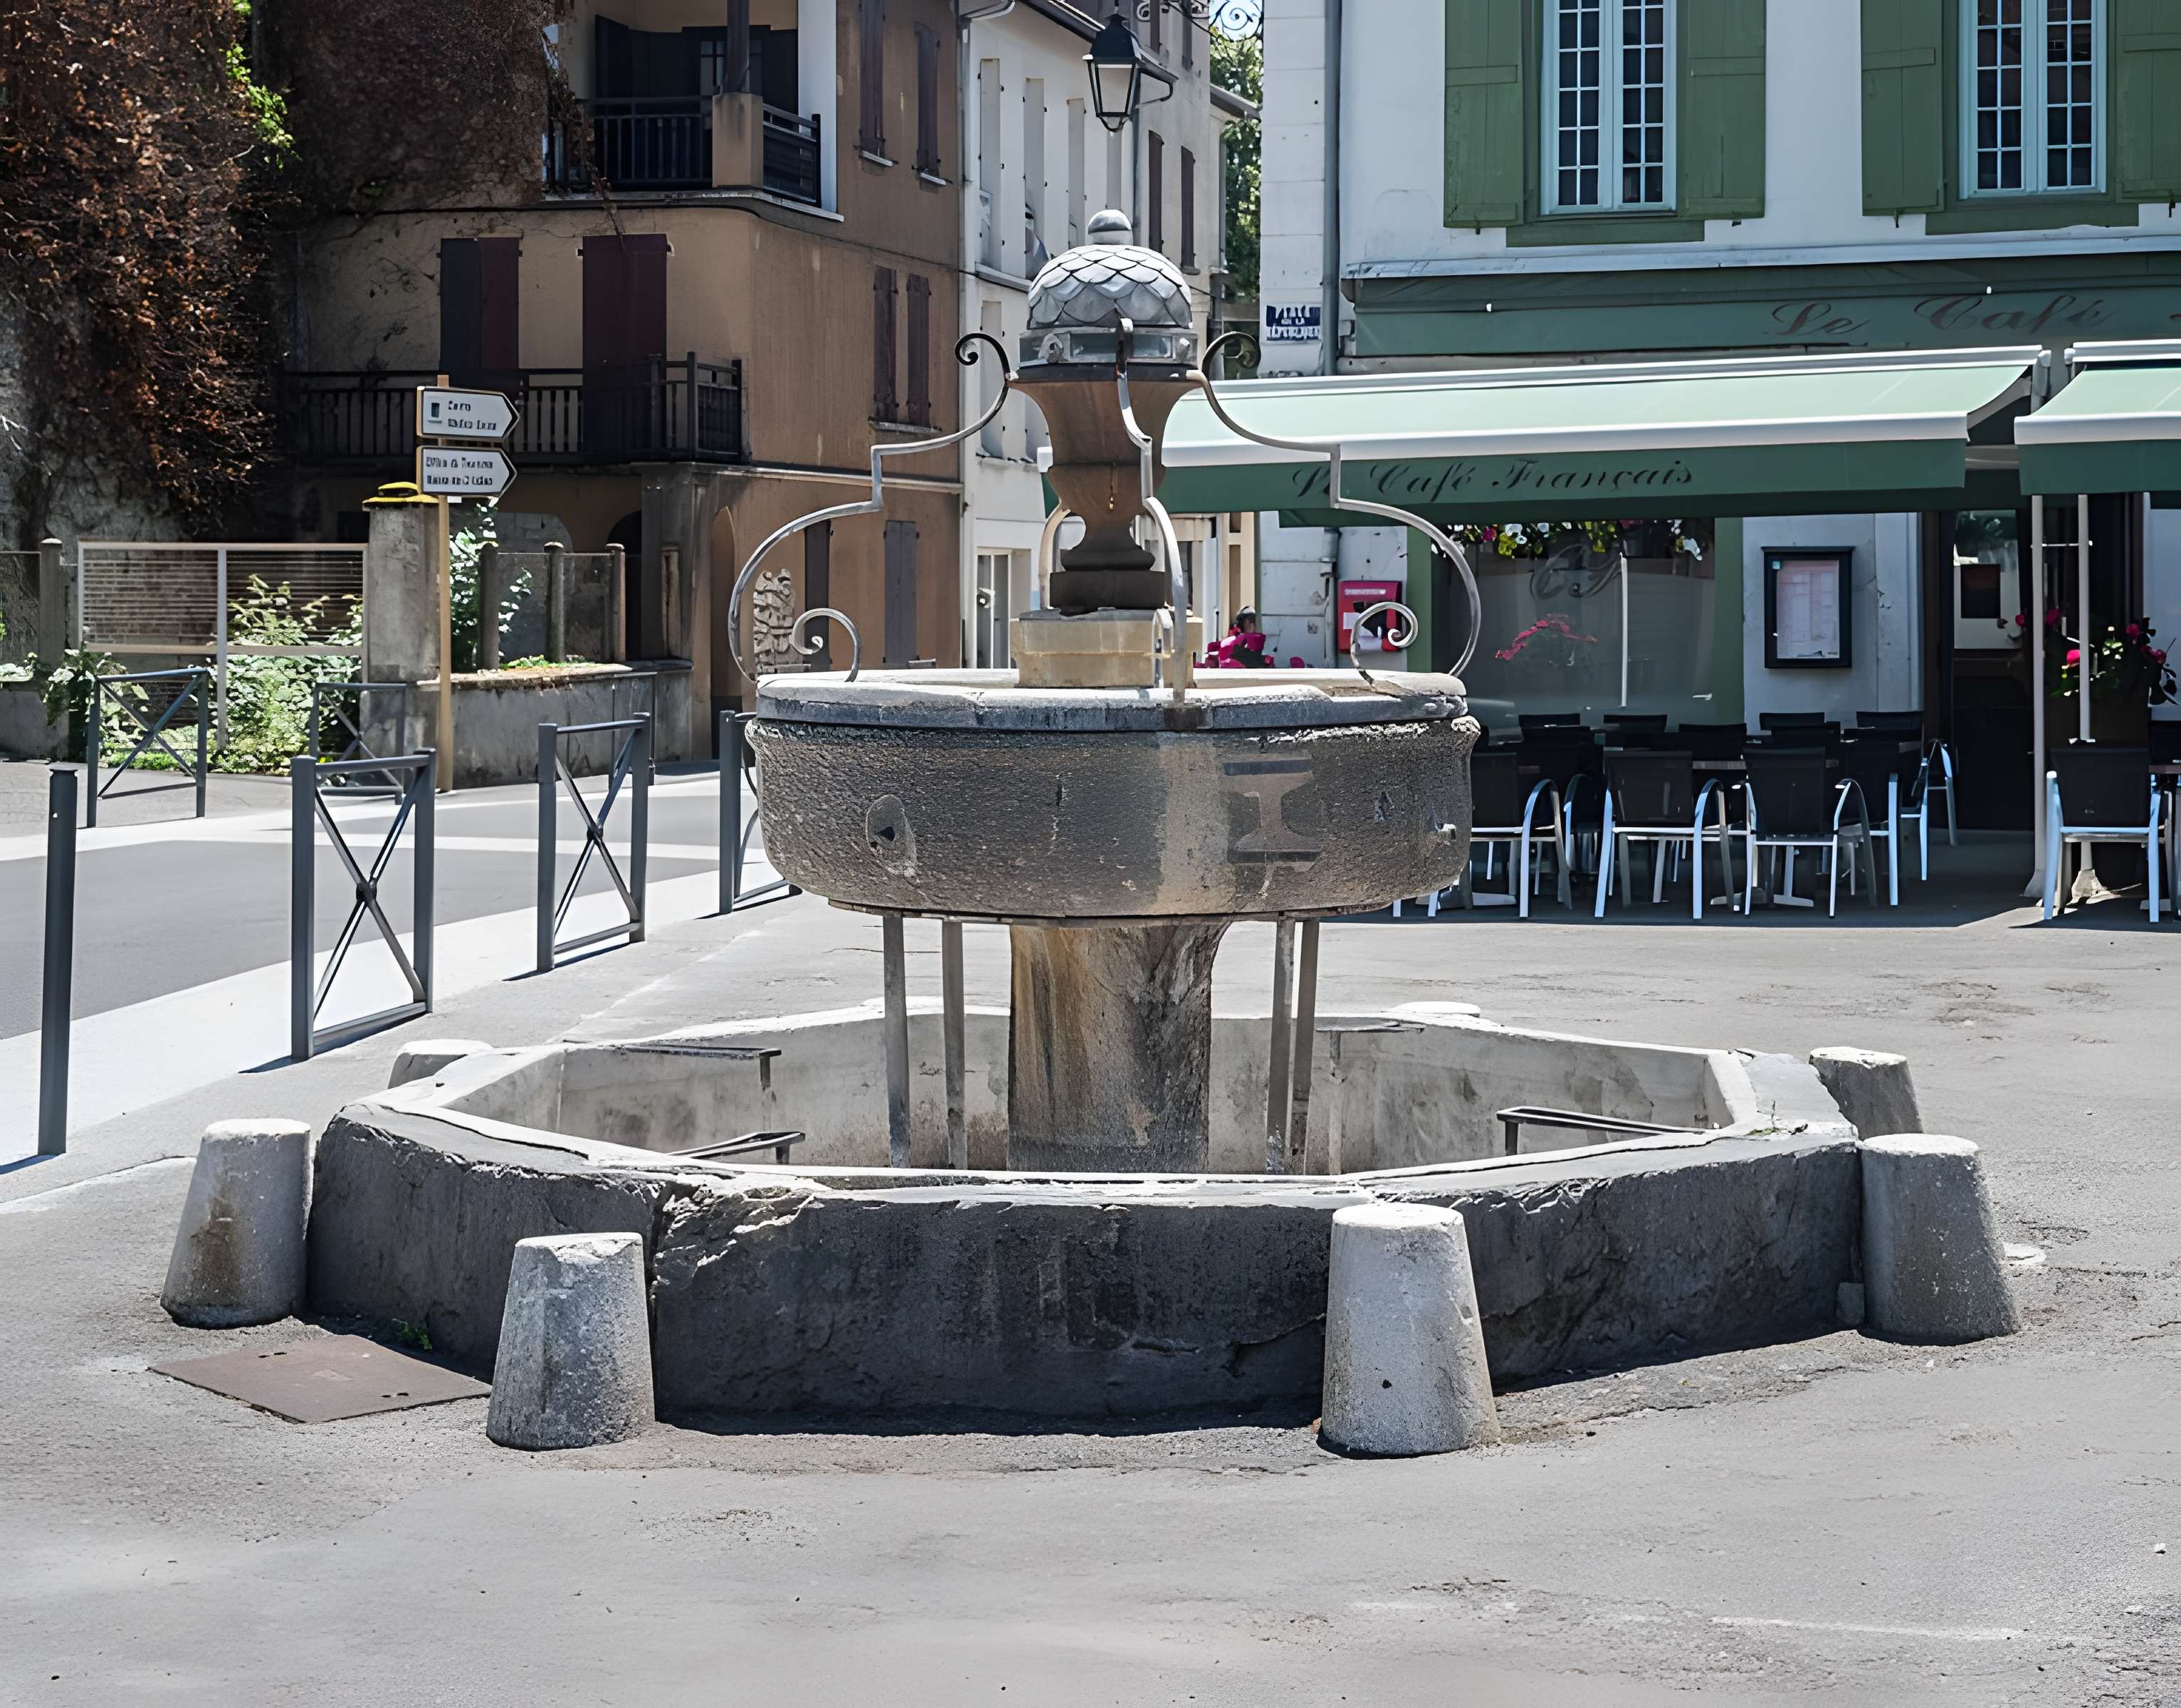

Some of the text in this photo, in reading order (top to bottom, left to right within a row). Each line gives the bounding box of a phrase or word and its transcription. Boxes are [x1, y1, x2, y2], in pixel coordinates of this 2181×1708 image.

[1767, 294, 2117, 337] Le Café
[1369, 462, 1476, 502] Café
[1492, 458, 1693, 490] Français
